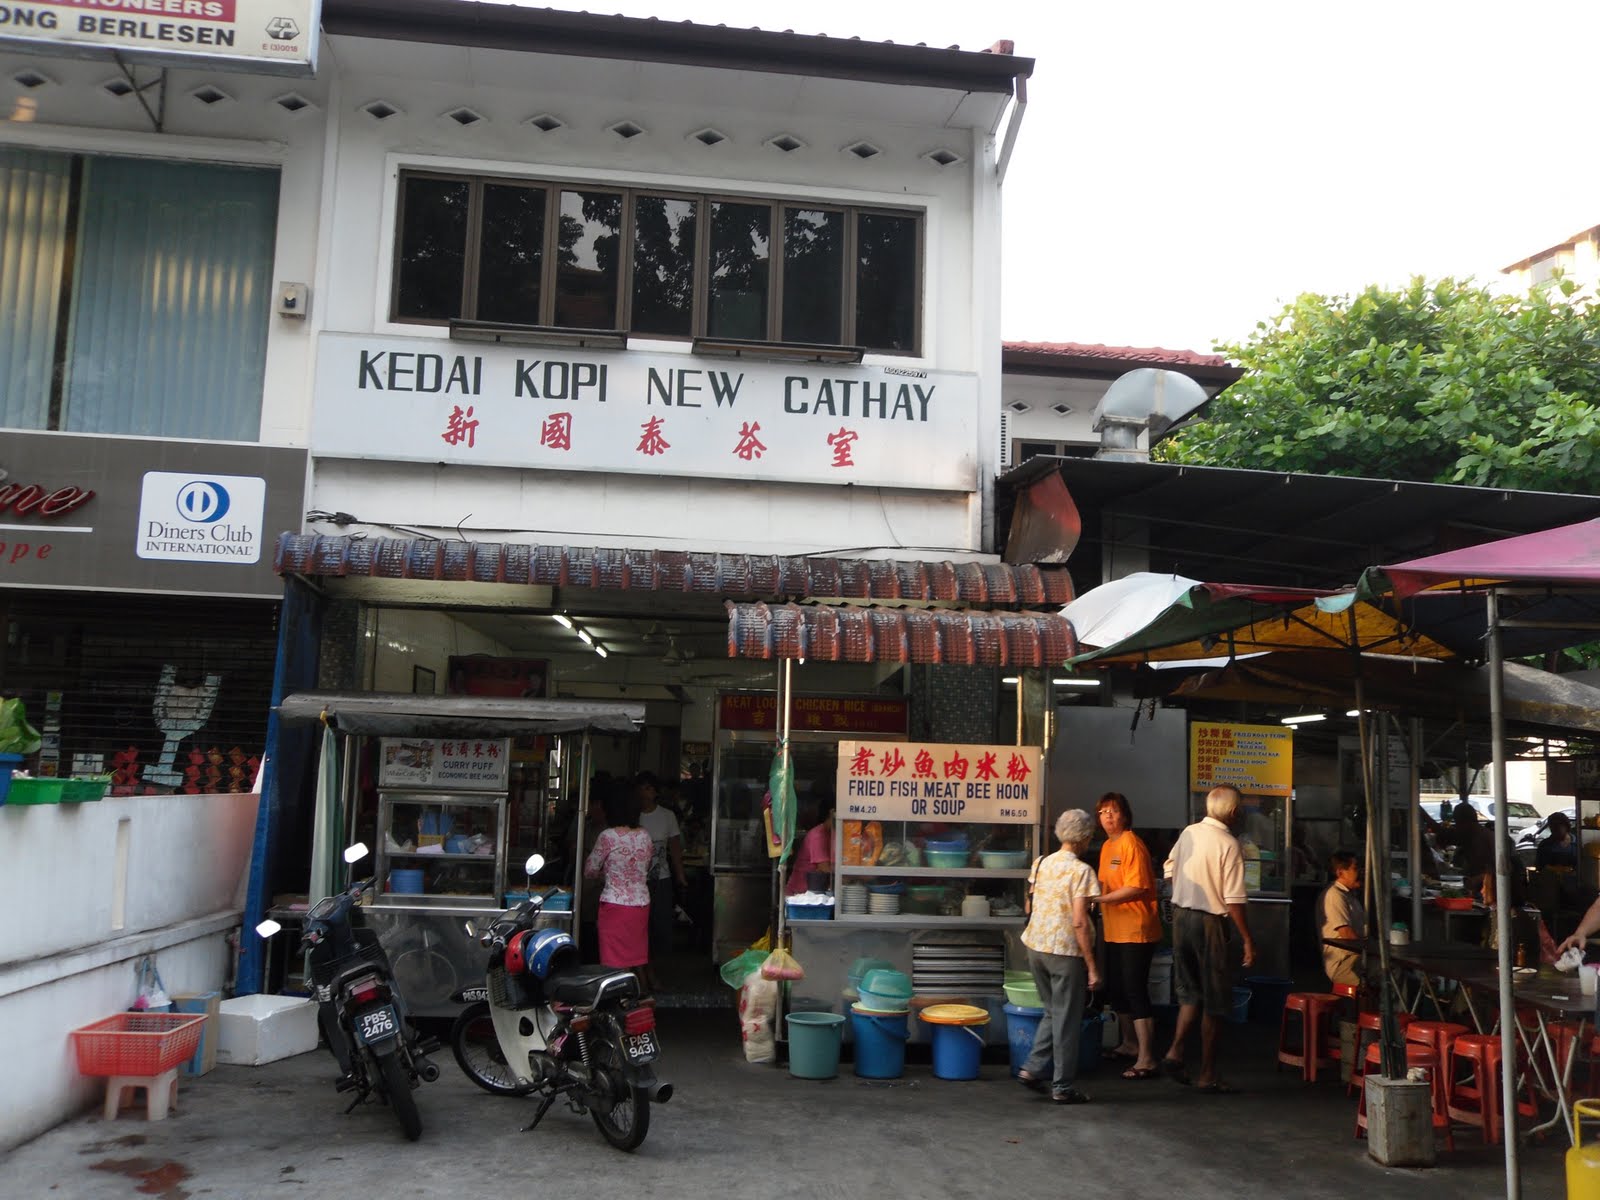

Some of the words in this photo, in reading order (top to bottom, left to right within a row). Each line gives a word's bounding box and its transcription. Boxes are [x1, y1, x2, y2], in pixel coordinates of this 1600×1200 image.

[78, 15, 235, 46] BERLESEN
[358, 350, 483, 395] KEDAI
[514, 359, 608, 402] KOPI
[647, 367, 744, 408] NEW
[784, 376, 936, 422] CATHAY
[441, 405, 859, 468] 新國泰茶室
[147, 521, 205, 540] Diners
[210, 524, 253, 543] Club
[145, 541, 254, 556] INTERNATIONAL
[796, 698, 839, 712] CHICKEN
[844, 700, 865, 712] RICE
[443, 760, 470, 769] CURRY
[472, 761, 493, 770] PUFF
[849, 746, 1032, 782] 煮炒魚肉米粉
[438, 771, 468, 780] ECONOMIC
[469, 772, 481, 780] BEE
[849, 780, 884, 797] FRIED
[890, 781, 918, 798] FISH
[924, 782, 960, 799] MEAT
[966, 783, 991, 799] BEE
[996, 784, 1029, 800] HOON
[849, 805, 877, 814] RM4.20
[911, 799, 927, 815] OR
[933, 800, 965, 816] SOUP
[1000, 809, 1028, 818] RM6.50
[363, 1010, 387, 1027] PBS
[363, 1019, 393, 1038] 2476
[629, 1033, 650, 1047] PAS
[629, 1042, 655, 1058] 9431
